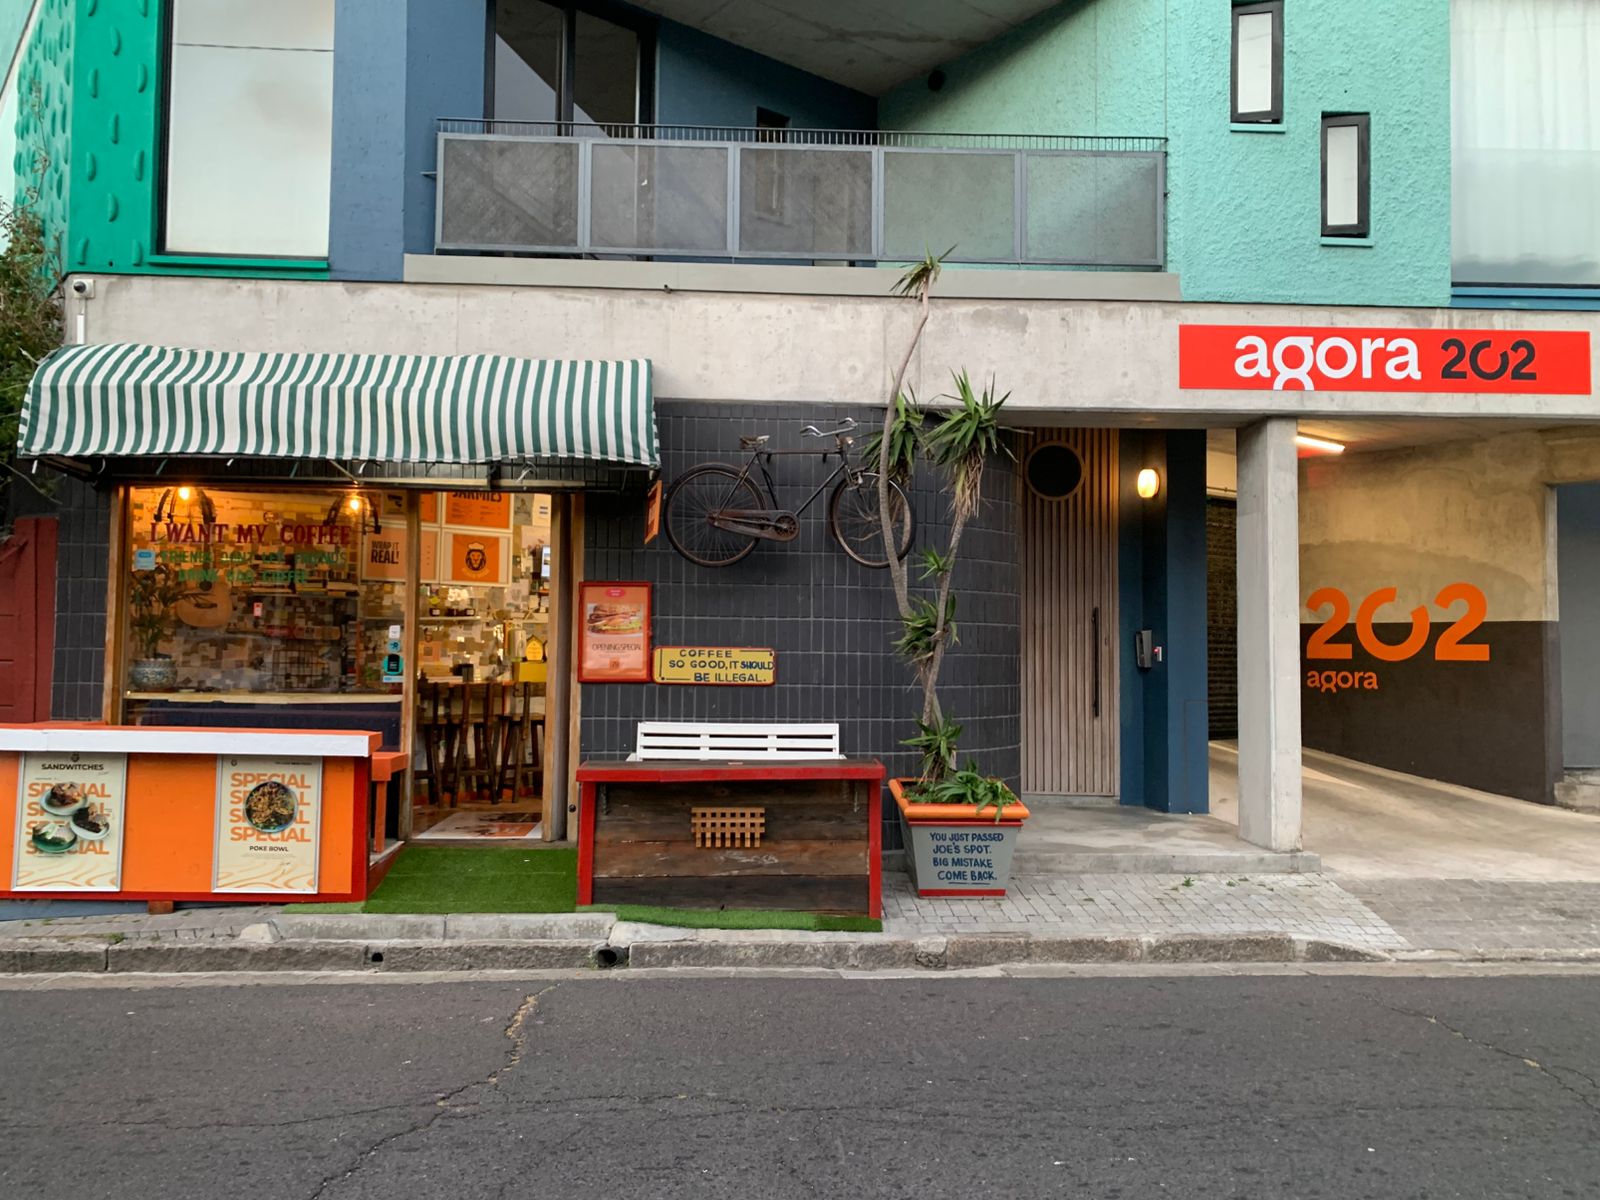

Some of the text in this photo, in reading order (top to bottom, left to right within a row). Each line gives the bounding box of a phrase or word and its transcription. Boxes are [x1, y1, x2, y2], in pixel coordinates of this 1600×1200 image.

[1233, 335, 1537, 391] agora 202
[150, 522, 352, 545] I WANT MY COFFEE
[371, 550, 399, 565] REAL!
[1306, 581, 1490, 662] 202
[679, 648, 733, 659] COFFEE
[668, 659, 686, 669] SO
[740, 660, 775, 671] SHOULD
[694, 672, 767, 683] BE ILLEGAL.
[1307, 670, 1379, 693] agora
[41, 763, 104, 771] SANDWITCHES
[230, 826, 311, 843] SPECIAL
[929, 832, 1005, 843] YOU JUST PASSED
[933, 842, 992, 855] JOE'S SPOT.
[932, 857, 993, 869] BIG MISTAKE
[937, 870, 997, 881] COME BACK.
